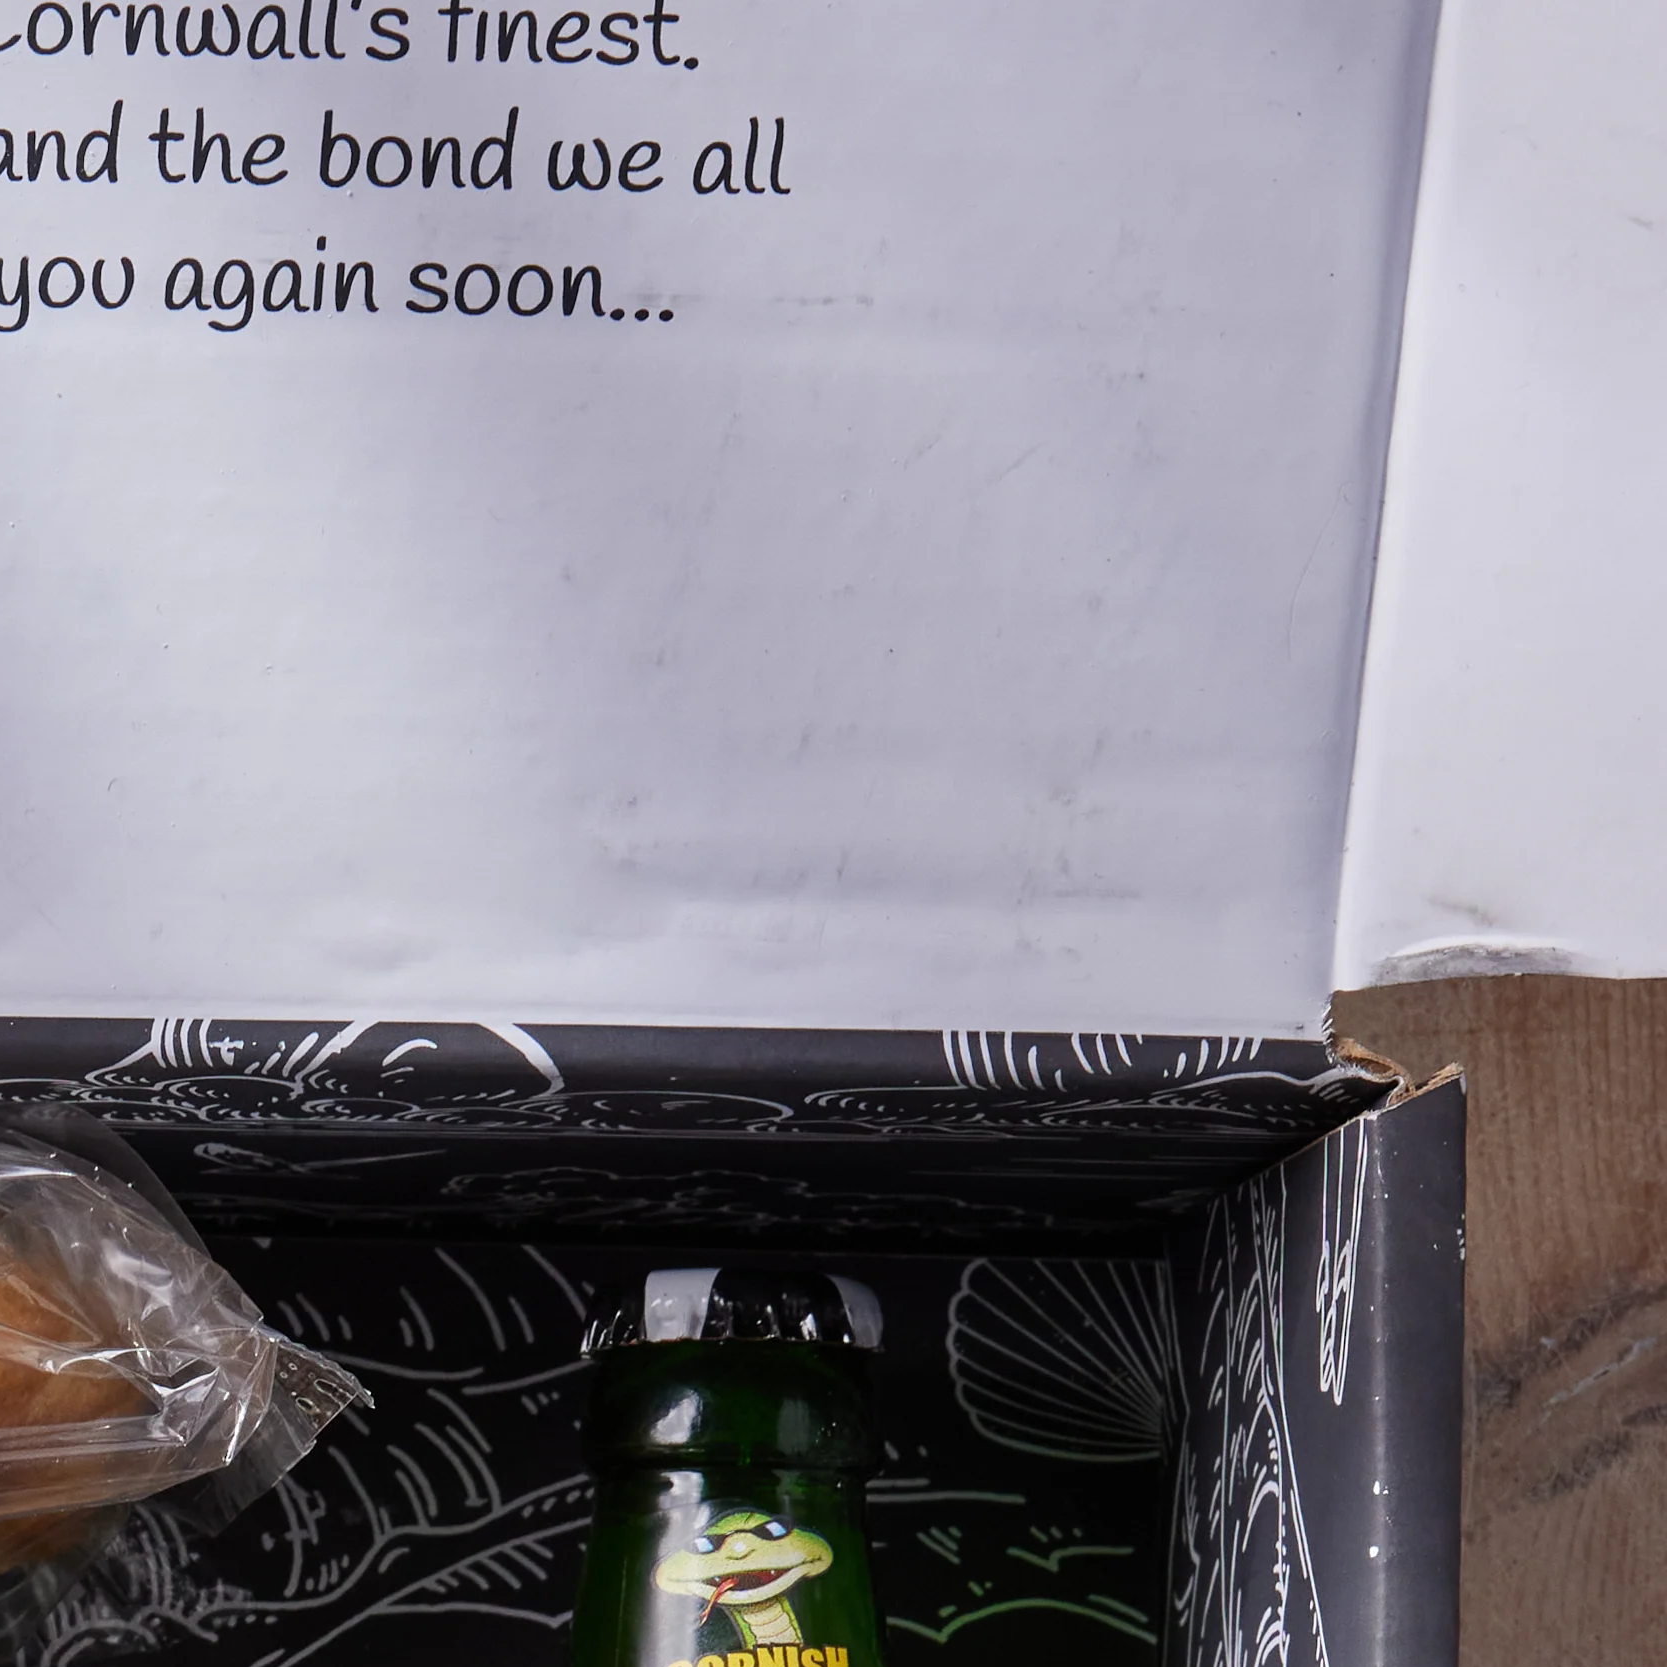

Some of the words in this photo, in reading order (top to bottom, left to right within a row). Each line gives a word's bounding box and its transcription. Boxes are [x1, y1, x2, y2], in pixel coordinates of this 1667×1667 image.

[149, 108, 288, 185] the
[320, 107, 519, 190] bond
[548, 139, 663, 192] we
[693, 117, 790, 194] all
[165, 236, 379, 331] again
[406, 263, 677, 321] soon...
